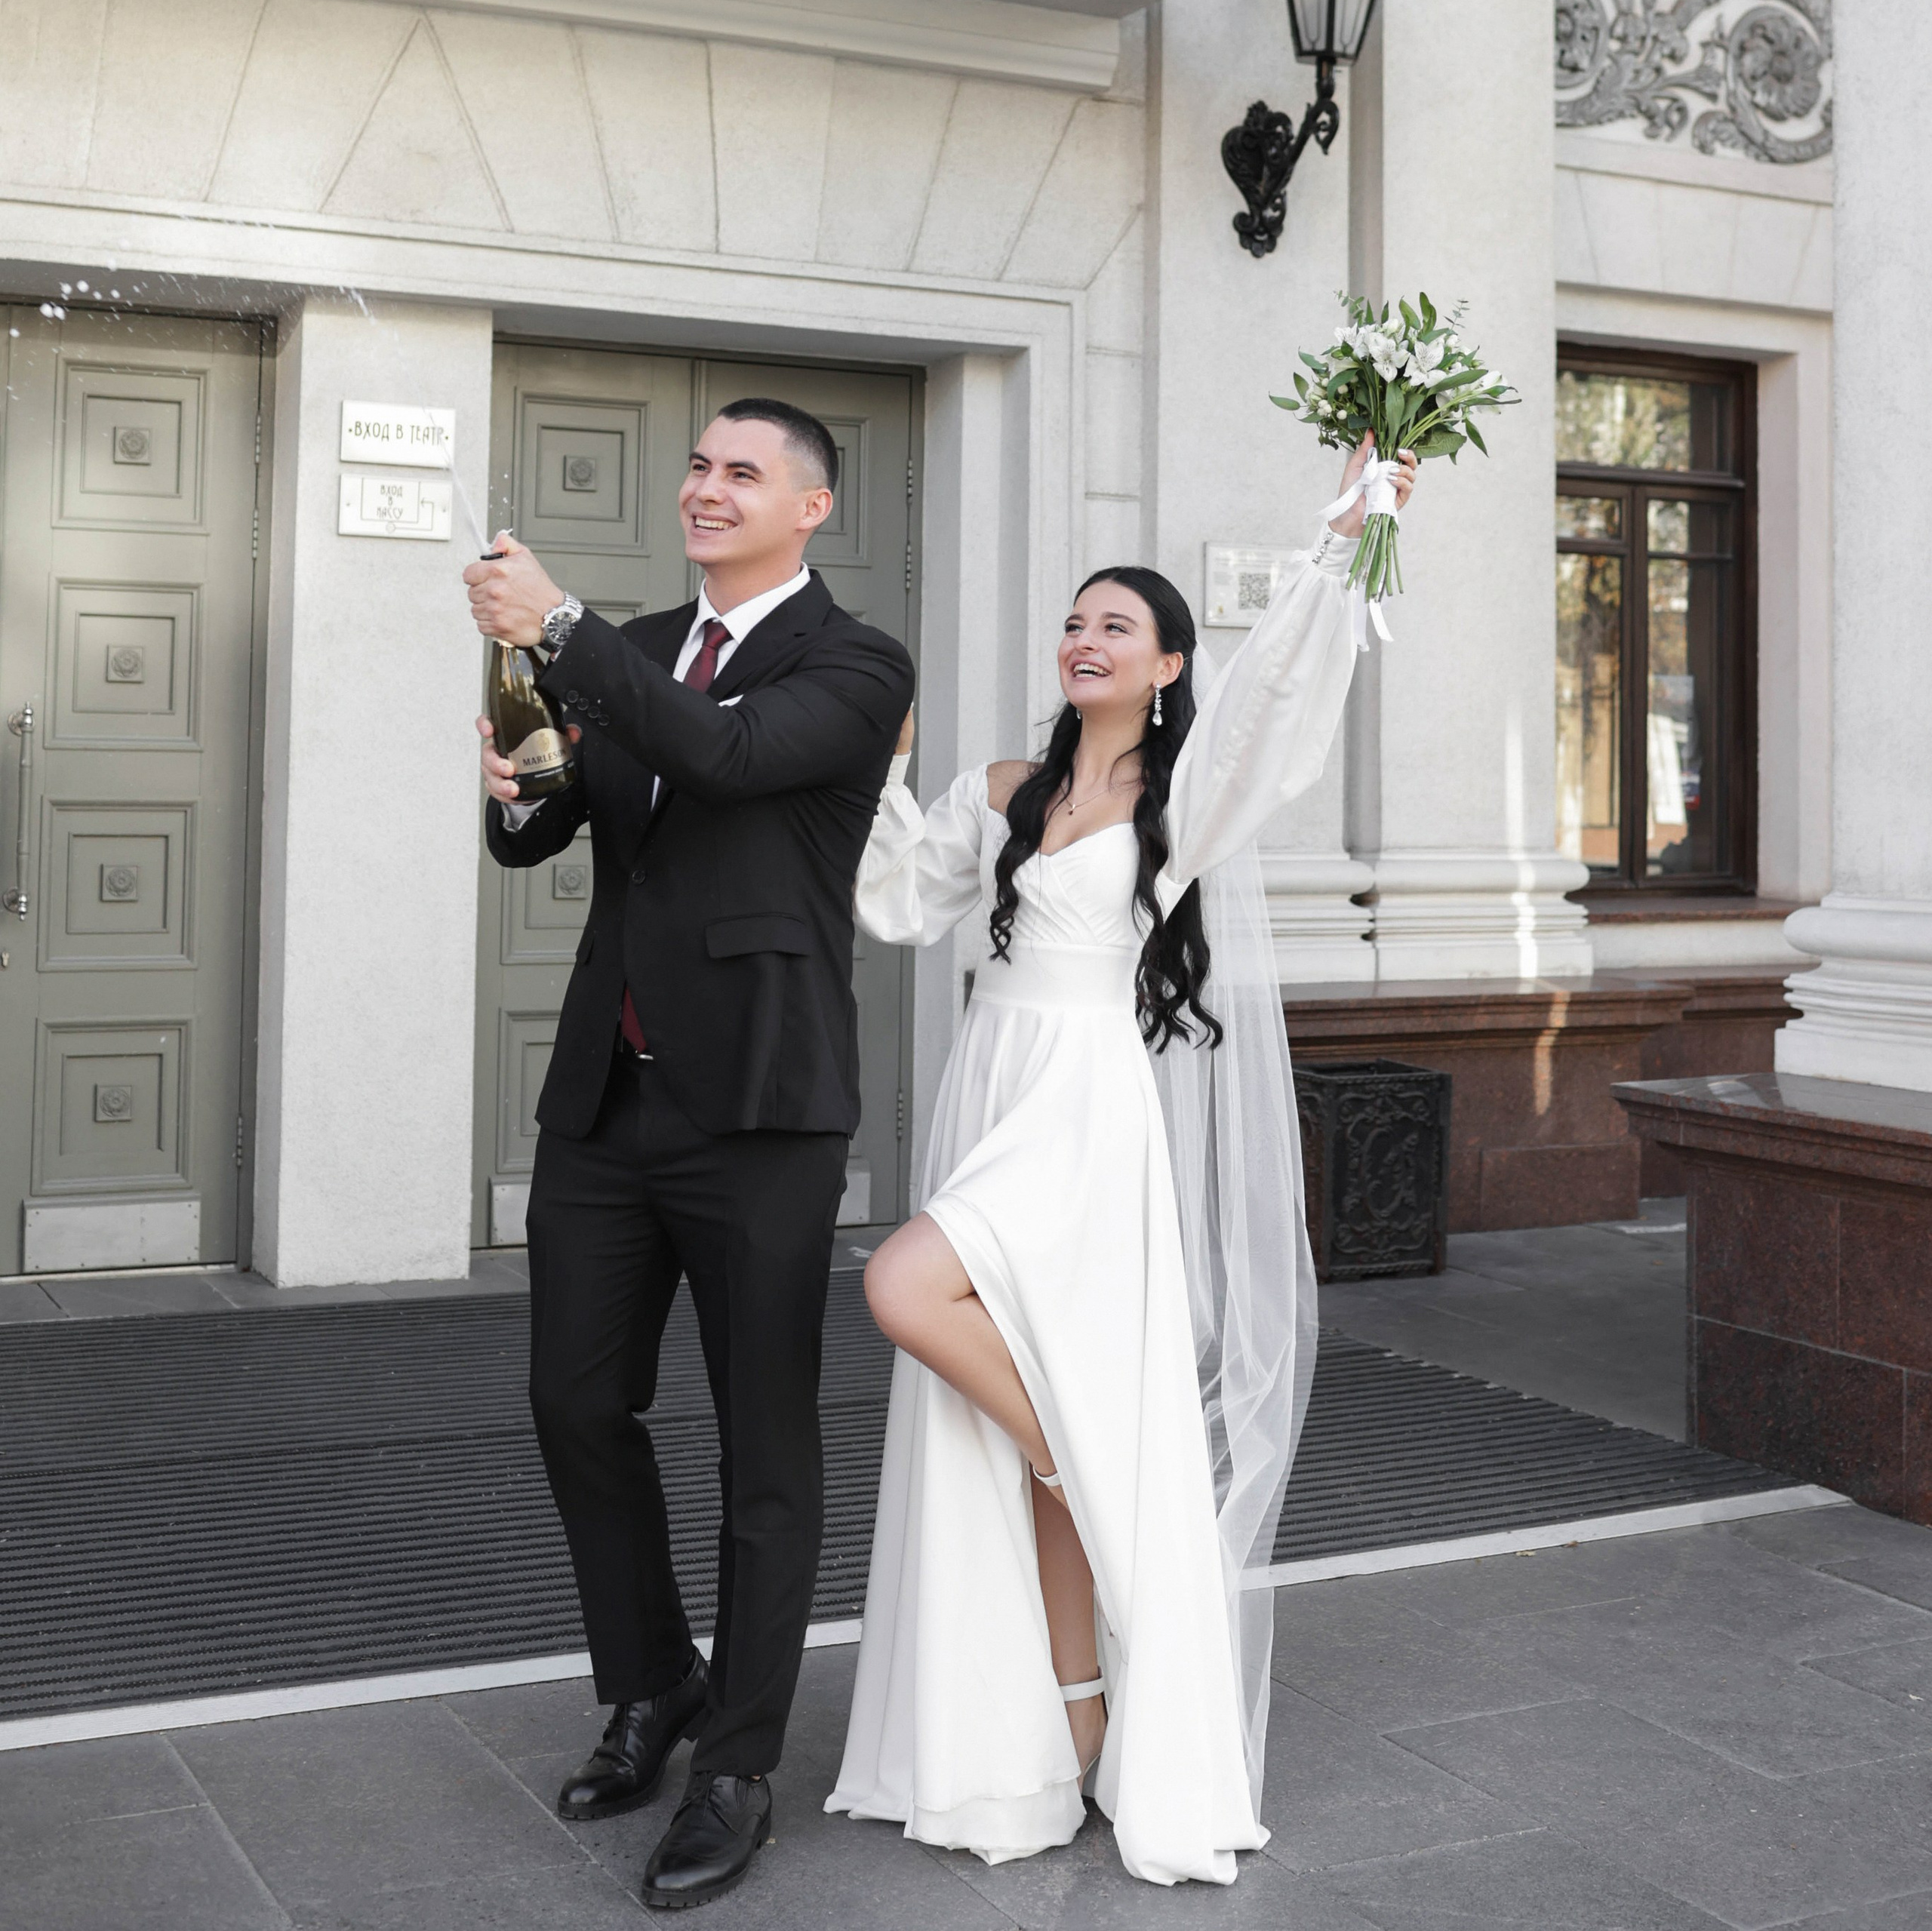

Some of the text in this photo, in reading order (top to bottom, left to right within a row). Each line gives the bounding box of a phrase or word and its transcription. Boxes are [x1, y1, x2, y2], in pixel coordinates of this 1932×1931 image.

[354, 420, 444, 446] ВХОД В ТЕАТР
[380, 484, 402, 497] ВХОД
[388, 497, 393, 506] В
